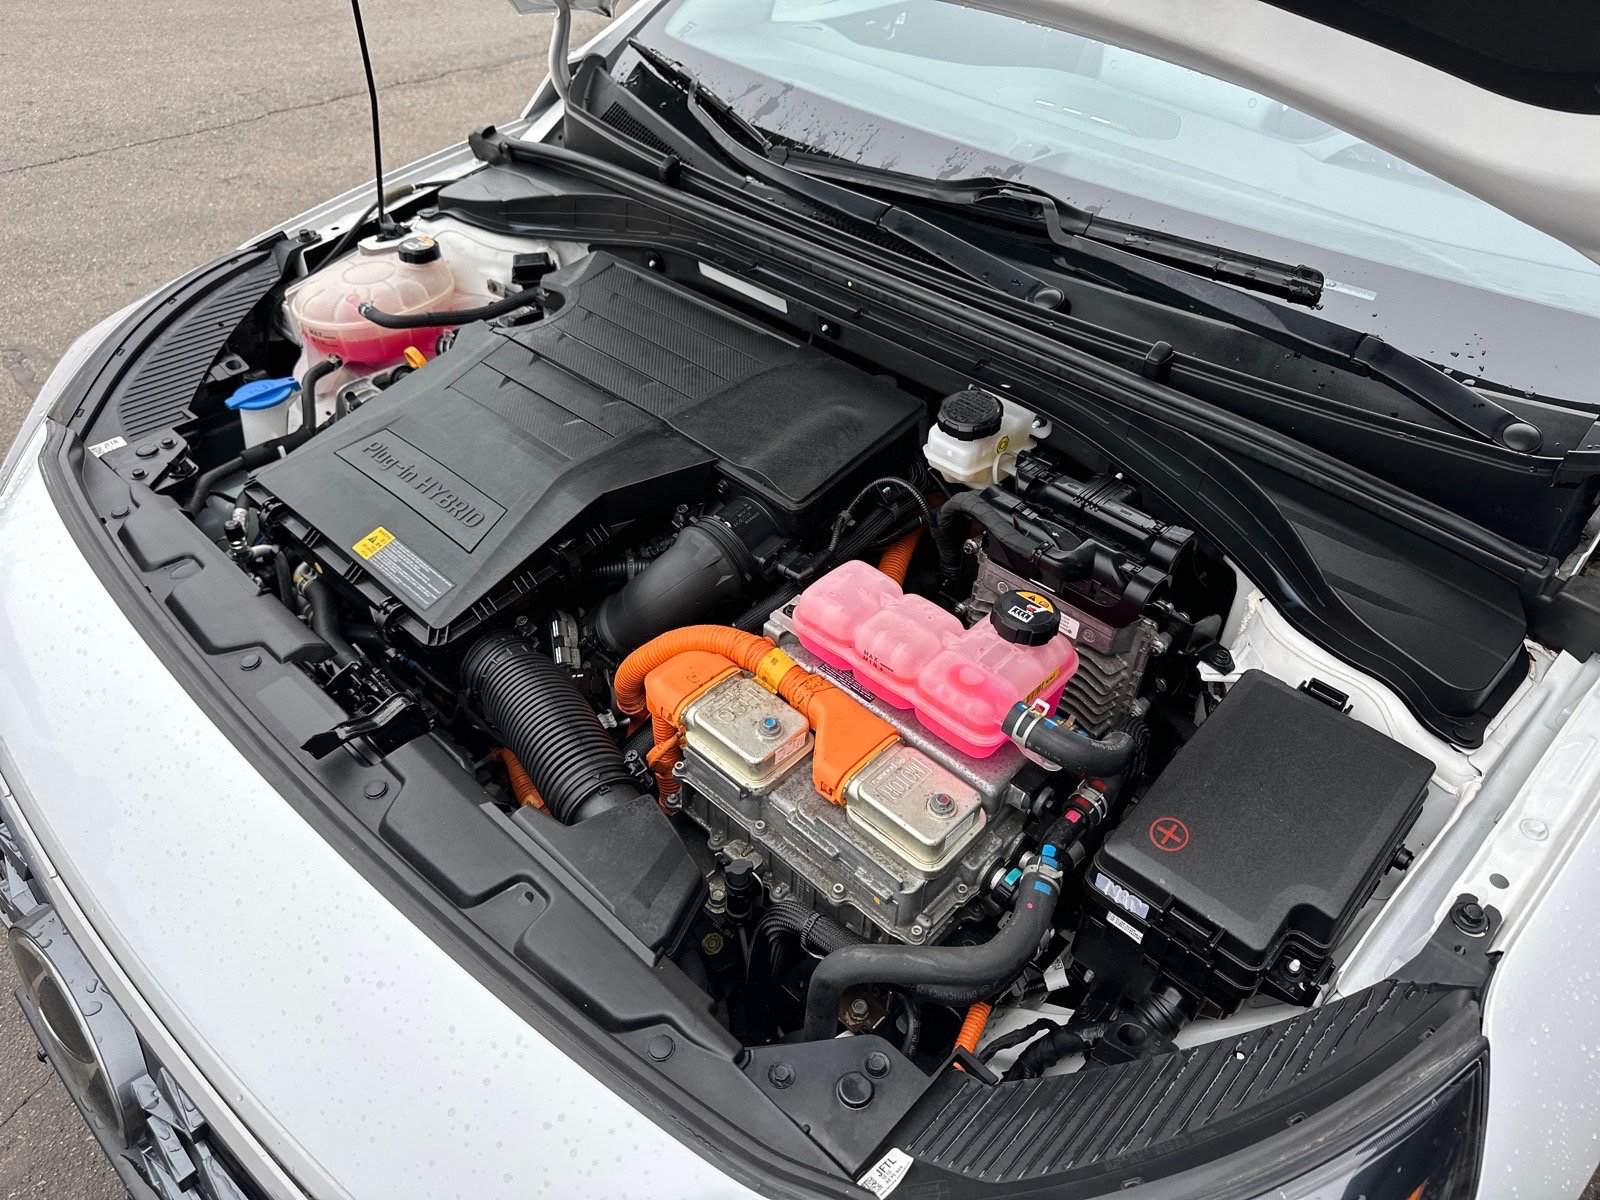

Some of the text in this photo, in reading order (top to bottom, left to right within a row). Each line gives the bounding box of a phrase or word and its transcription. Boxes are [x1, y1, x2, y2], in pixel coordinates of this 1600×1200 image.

[362, 441, 486, 528] Plug-in HYBRID
[863, 649, 879, 662] MAX
[880, 762, 926, 800] MOTOR
[876, 1158, 897, 1177] JFTL
